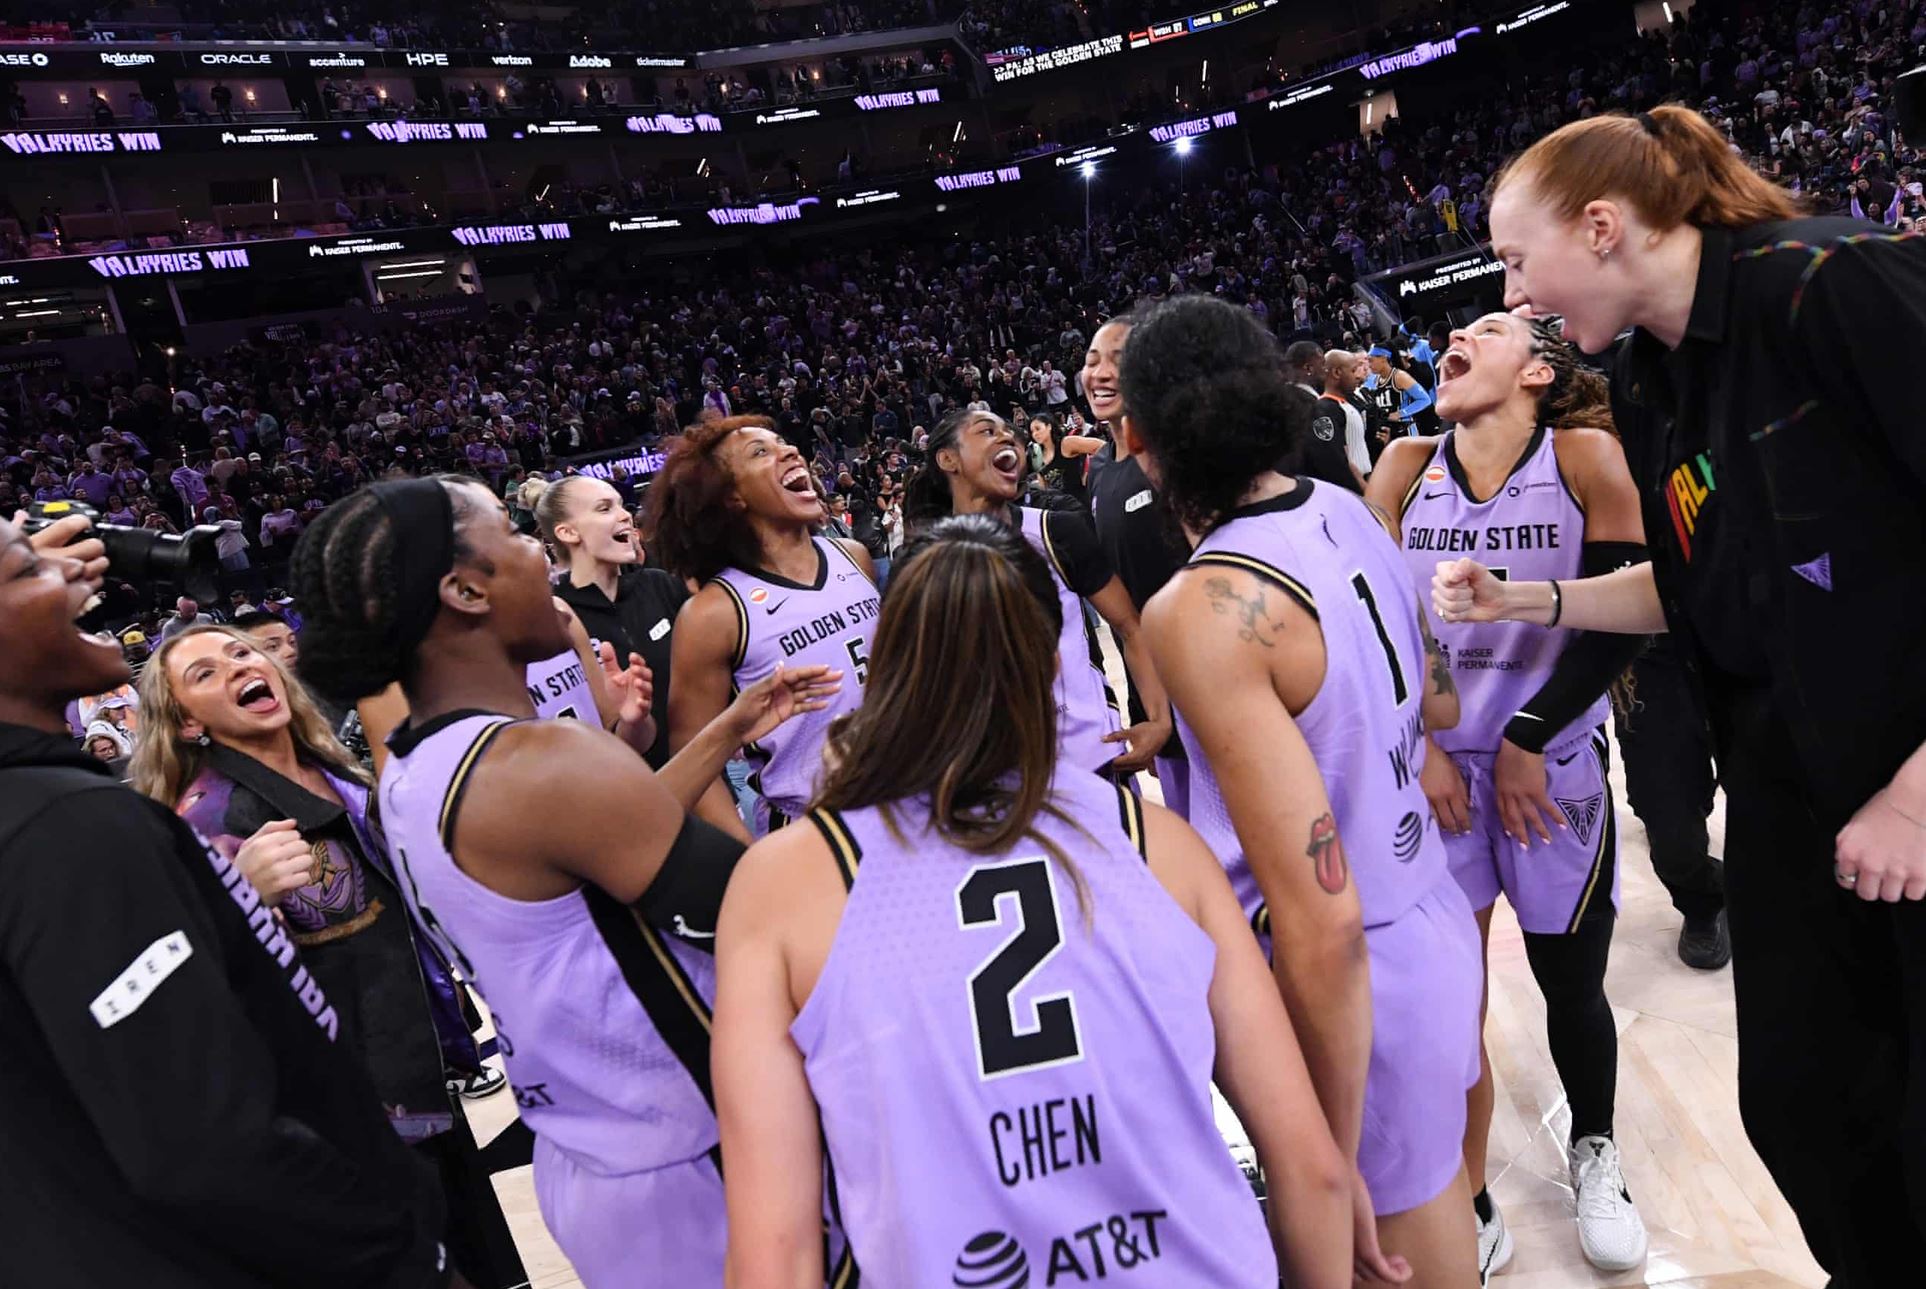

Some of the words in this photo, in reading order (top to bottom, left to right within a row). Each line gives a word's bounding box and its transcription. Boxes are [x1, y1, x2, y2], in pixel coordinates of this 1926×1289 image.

[100, 52, 155, 65] Rakuten
[200, 54, 273, 64] ORACLE
[406, 53, 449, 66] HPE
[1023, 57, 1035, 68] AS
[1035, 53, 1050, 63] WE
[1051, 40, 1102, 60] CELEBRATE
[1101, 35, 1123, 47] THIS
[1429, 38, 1457, 59] WIN
[309, 56, 365, 67] accenture
[491, 55, 533, 65] verizon
[569, 55, 612, 68] Adobe
[636, 56, 686, 66] ticketmaster
[995, 71, 1015, 82] WIN
[1016, 66, 1035, 77] FOR
[1036, 60, 1054, 72] THE
[1055, 51, 1093, 67] GOLDEN
[1093, 43, 1122, 57] STATE
[853, 91, 915, 110] VALKYRIES
[915, 88, 941, 104] WIN
[366, 122, 453, 141] VALKYRIES
[454, 123, 488, 139] WIN
[626, 116, 695, 133] VALKYES
[694, 115, 722, 132] WIN
[1148, 117, 1211, 142] VALKYRIES
[1212, 111, 1238, 129] WIN
[0, 132, 115, 154] VALKYRIES
[117, 132, 162, 151] WIN
[934, 170, 995, 191] VALKYRIES
[996, 166, 1021, 183] WIN
[707, 207, 776, 225] VALKYRI
[774, 204, 801, 221] WIN
[451, 224, 536, 245] VALKYRIES
[538, 223, 571, 240] WIN
[88, 252, 203, 277] VALKYRIES
[206, 248, 250, 269] WIN
[1471, 257, 1481, 266] BY
[1418, 275, 1451, 292] KAISER
[1408, 526, 1479, 552] GOLDEN
[1485, 523, 1560, 551] STATE
[779, 611, 847, 657] GOLDEN
[1349, 567, 1408, 709] 1
[844, 636, 870, 688] 5
[1457, 648, 1494, 658] KAISER
[545, 663, 587, 697] STAT
[953, 855, 1086, 1082] 2
[988, 1093, 1102, 1188] CHEN
[1045, 1209, 1168, 1288] AT&T
